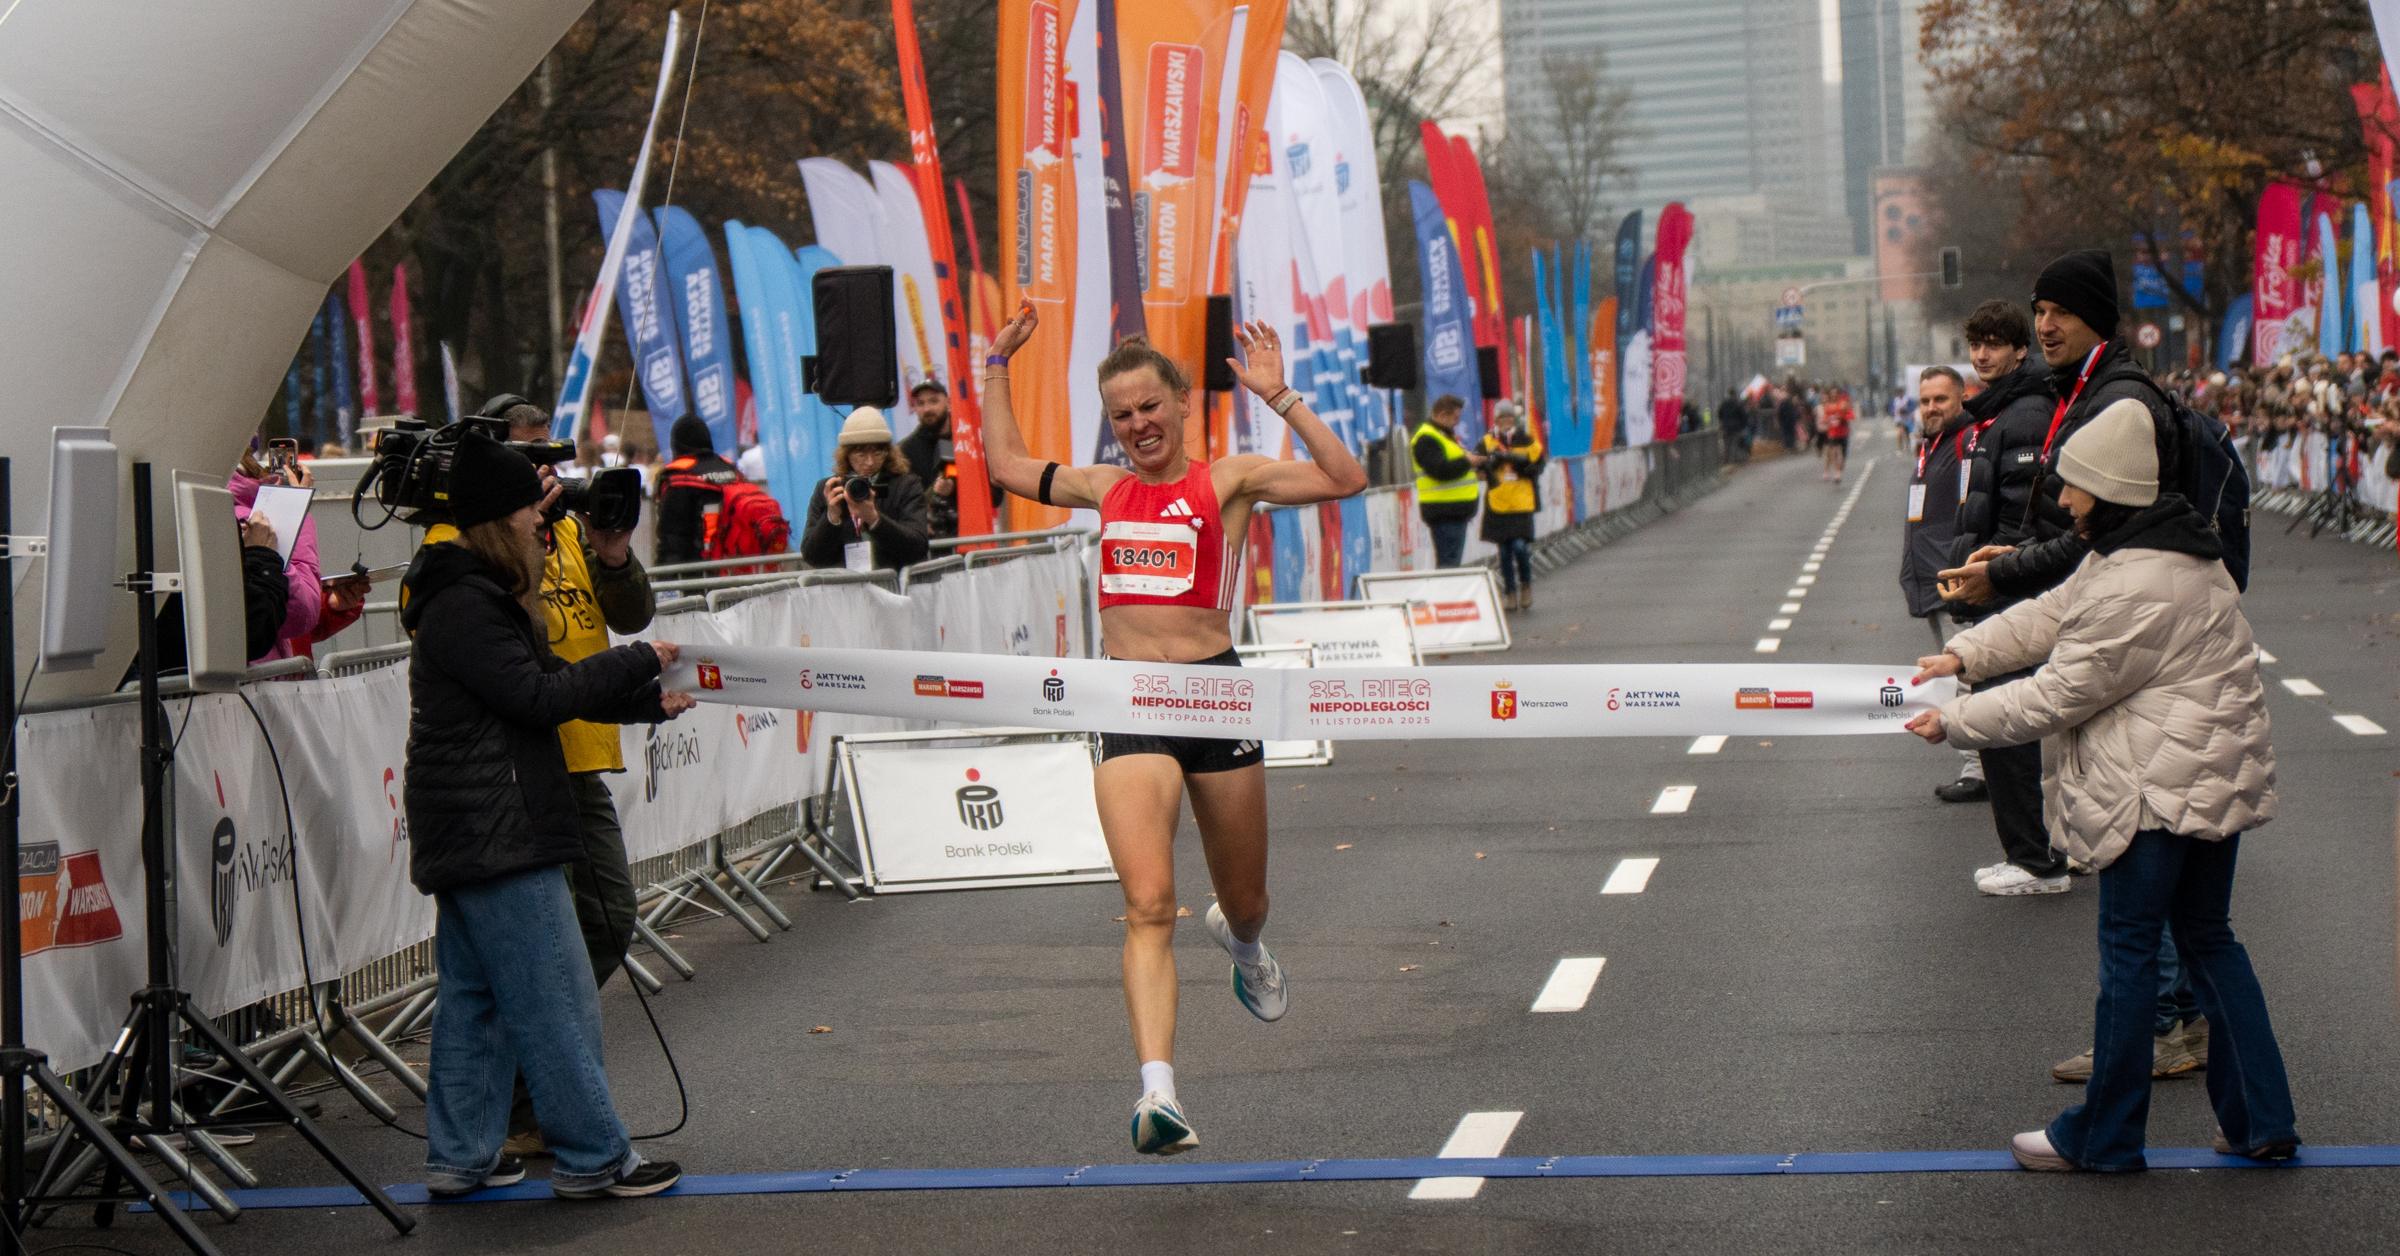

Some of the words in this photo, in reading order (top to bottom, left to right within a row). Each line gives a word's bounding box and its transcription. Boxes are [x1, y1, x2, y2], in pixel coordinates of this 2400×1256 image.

[1042, 12, 1057, 144] WARSZAWSKI
[1162, 51, 1187, 167] WARSZAWSKI
[1016, 174, 1029, 280] FUNDACJA
[1040, 184, 1055, 283] MARATON
[1158, 201, 1176, 289] MARATON
[1112, 547, 1178, 569] 18401
[724, 673, 767, 684] Warszawa
[815, 672, 865, 682] AKTYWNA
[816, 681, 867, 690] WARSZAWA
[1185, 677, 1254, 698] BIEG
[1362, 679, 1431, 698] BIEG
[1132, 696, 1252, 712] NIEPODLEGŁOŚCI
[1310, 698, 1430, 712] NIEPODLEGŁOŚCI
[1521, 699, 1568, 708] Warszawa
[1132, 711, 1141, 719] 11
[1147, 712, 1215, 723] LISTOPADA
[1221, 716, 1252, 725] 2025
[1326, 717, 1393, 725] LISTOPADA
[1400, 716, 1431, 724] 2025
[945, 844, 984, 858] Bank
[988, 841, 1033, 856] Polski
